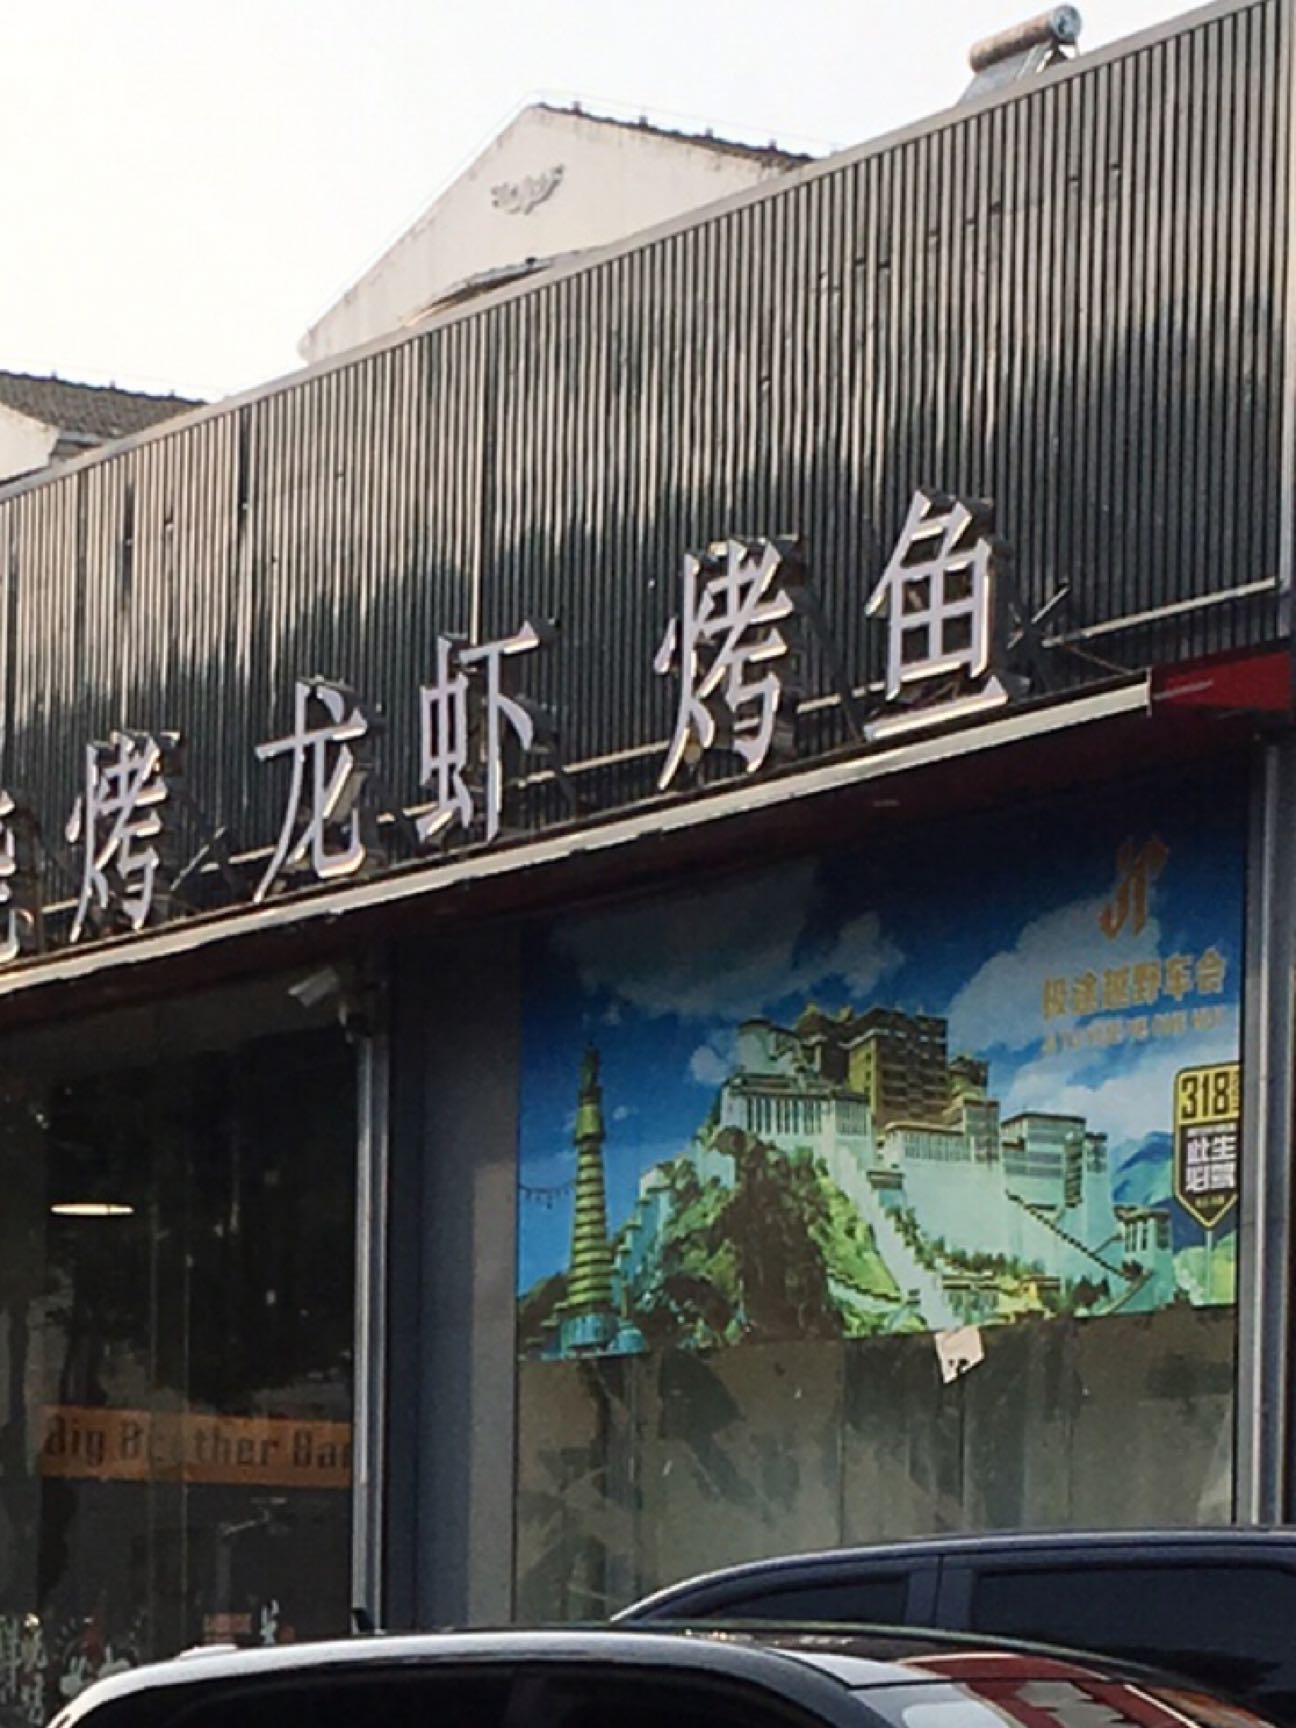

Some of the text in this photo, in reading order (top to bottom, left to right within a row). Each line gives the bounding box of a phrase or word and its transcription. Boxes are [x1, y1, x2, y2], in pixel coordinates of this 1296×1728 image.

[254, 618, 542, 903] 龙虾
[654, 488, 1008, 791] 烤鱼
[1181, 1071, 1230, 1119] 318
[43, 1412, 104, 1467] Big
